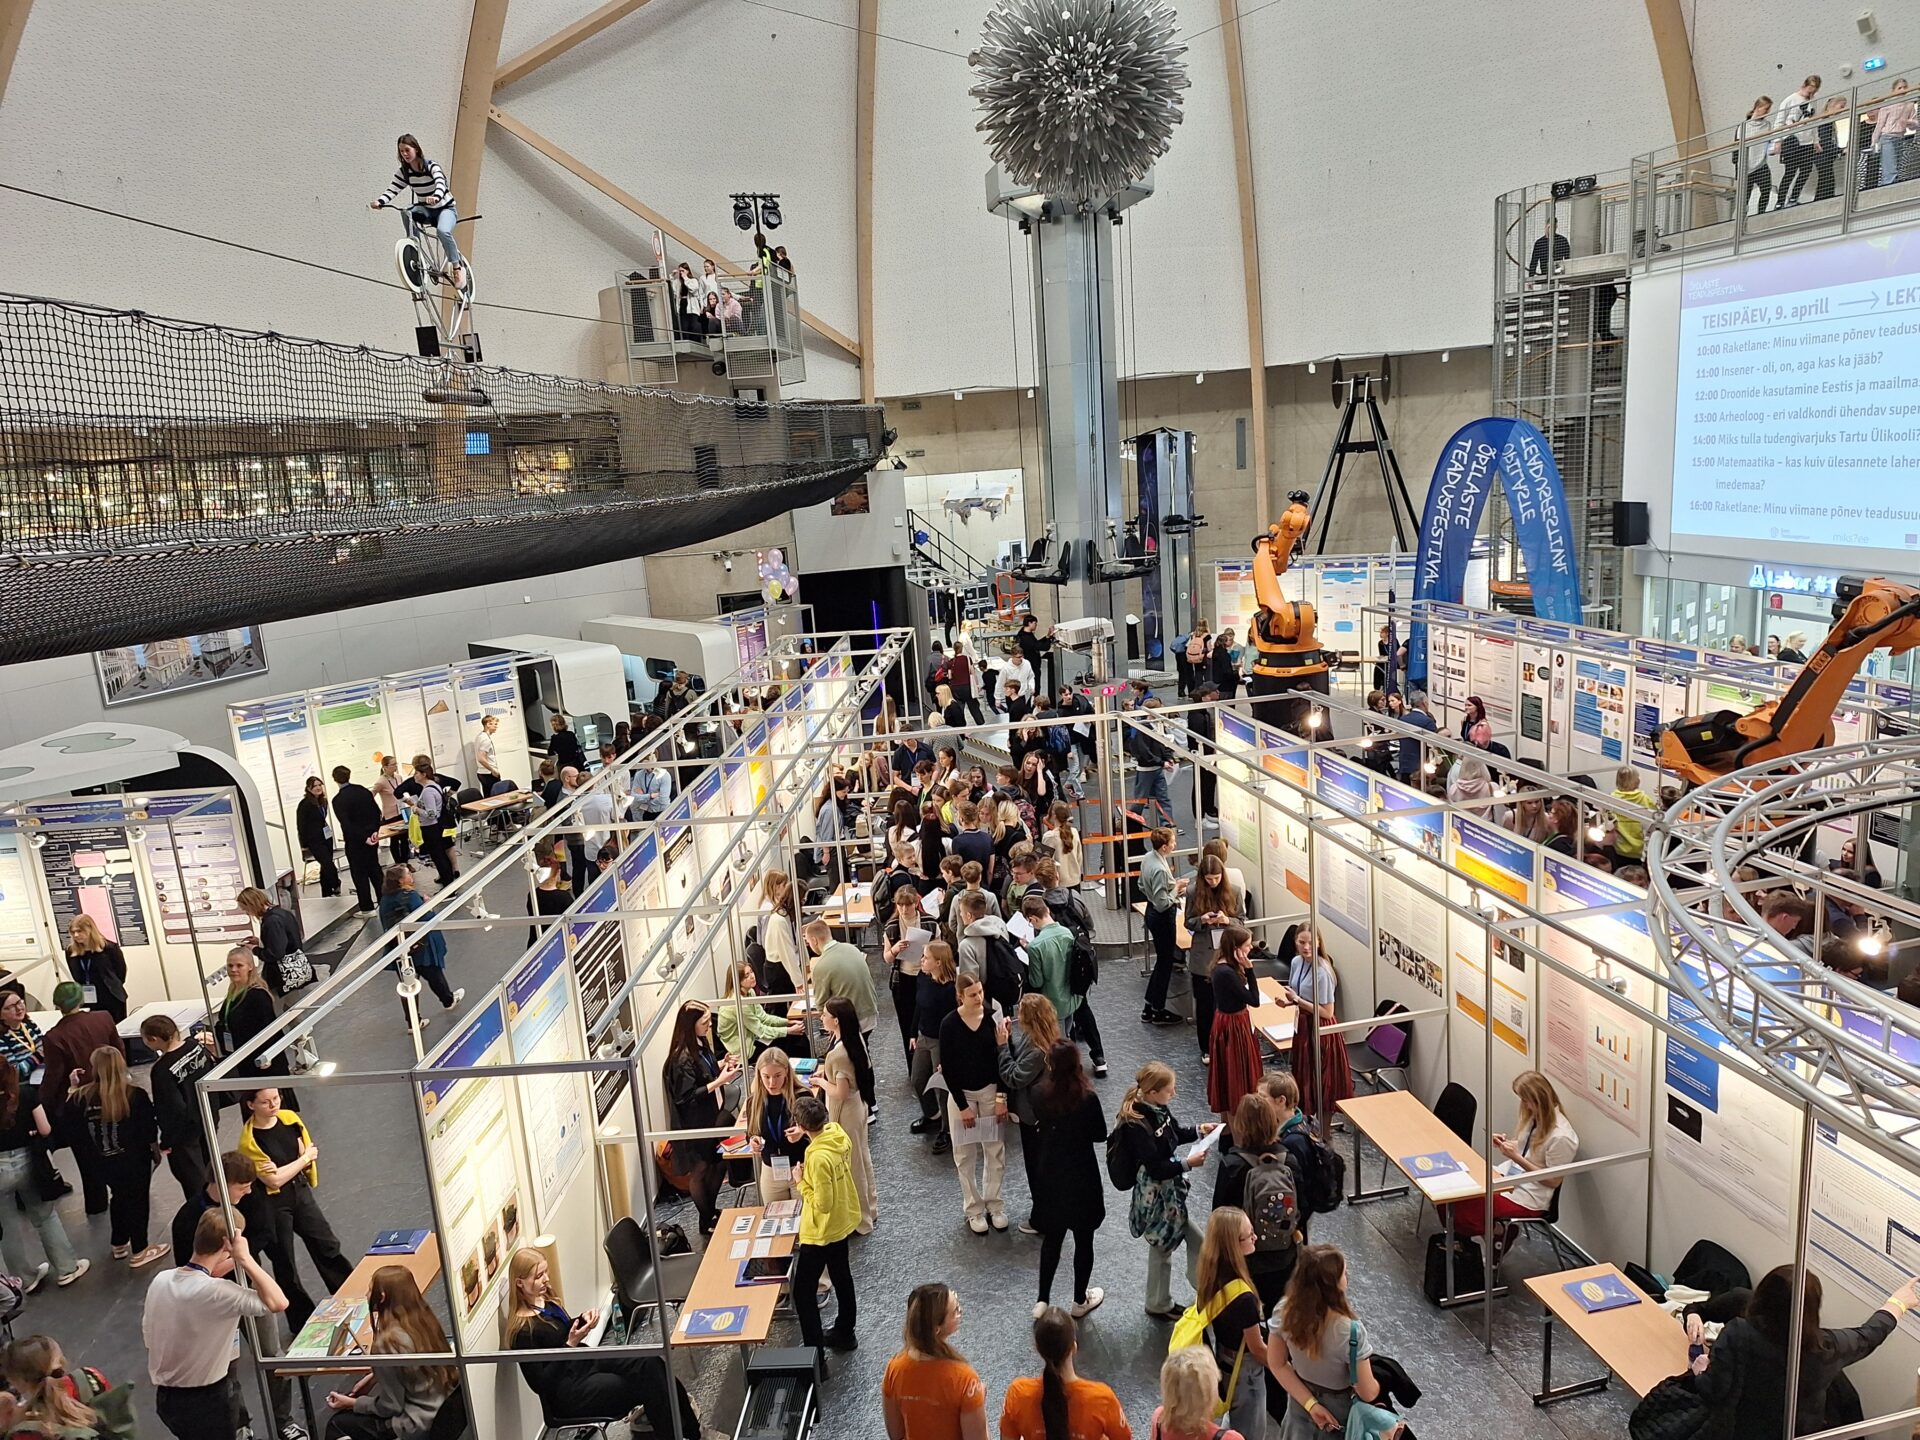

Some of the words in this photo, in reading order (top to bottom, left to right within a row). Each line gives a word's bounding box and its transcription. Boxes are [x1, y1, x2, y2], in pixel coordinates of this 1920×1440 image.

[1702, 305, 1772, 330] TEISIPÄEV,
[1775, 305, 1788, 321] 9.
[1791, 297, 1829, 322] aprill
[1697, 343, 1721, 357] 10:00
[1722, 340, 1771, 355] Raketlane:
[1773, 335, 1798, 349] Minu
[1799, 333, 1840, 347] viimane
[1842, 327, 1876, 344] põnev
[1878, 321, 1920, 338] teadus
[1696, 366, 1720, 379] 11:00
[1721, 365, 1755, 378] Insener
[1762, 361, 1777, 375] oli,
[1780, 362, 1795, 374] on,
[1797, 360, 1815, 375] aga
[1818, 356, 1835, 369] kas
[1838, 354, 1851, 367] ka
[1853, 351, 1884, 368] jääb?
[1695, 388, 1719, 401] 12:00
[1721, 384, 1761, 400] Droonide
[1762, 380, 1819, 398] kasutamine
[1822, 379, 1853, 394] Eestis
[1855, 378, 1867, 394] ja
[1693, 412, 1718, 424] 13:00
[1719, 410, 1765, 425] Arheoloog
[1773, 409, 1786, 421] eri
[1787, 405, 1837, 420] valdkondi
[1840, 404, 1887, 419] ühendav
[1692, 434, 1717, 446] 14:00
[1718, 432, 1739, 445] Miks
[1740, 431, 1762, 445] tulla
[1763, 430, 1837, 448] tudengivarjuks
[1839, 429, 1868, 444] Tartu
[1871, 427, 1920, 443] Ülikooli?
[1691, 456, 1716, 468] 15:00
[1716, 455, 1775, 469] Matemaatika
[1785, 455, 1802, 468] kas
[1803, 455, 1826, 469] kuiv
[1827, 455, 1888, 469] ülesannete
[1454, 443, 1498, 530] ÕPILASTE
[1715, 478, 1766, 491] imedemaa?
[1422, 438, 1473, 590] TEADUSFESTIVAL
[1689, 499, 1713, 512] 16:00
[1714, 501, 1762, 514] Raketlane:
[1763, 504, 1787, 516] Minu
[1789, 505, 1829, 518] viimane
[1830, 505, 1863, 520] põnev
[1865, 506, 1920, 522] teadusuu
[1766, 570, 1812, 592] Labor
